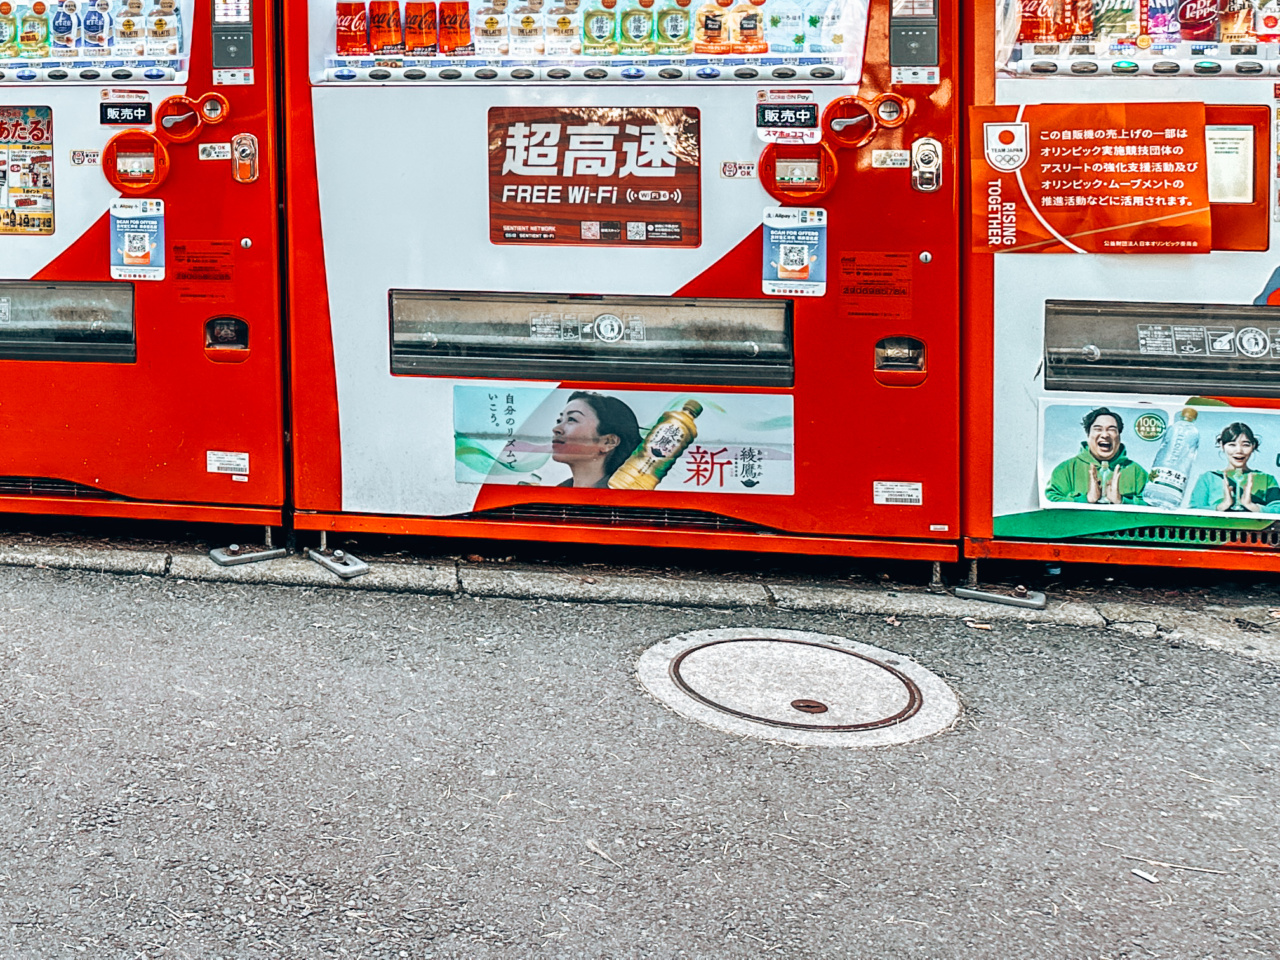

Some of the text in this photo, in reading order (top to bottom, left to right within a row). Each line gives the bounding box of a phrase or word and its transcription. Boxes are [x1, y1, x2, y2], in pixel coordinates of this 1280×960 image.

[797, 94, 809, 102] Pay
[107, 107, 147, 120] 販売中
[764, 109, 811, 123] 販売中
[1040, 128, 1188, 141] この自販機の売上げの一部は
[502, 122, 678, 178] 超高速
[1040, 145, 1184, 157] オリンピック実施競技団体の
[1040, 162, 1198, 173] アスリートの強化支援活動及び
[502, 185, 563, 203] FREE
[568, 185, 618, 204] Wi-Fi
[1040, 195, 1193, 207] 推進活動などに活用されます。
[988, 178, 1002, 246] TOGETHER
[1002, 202, 1016, 246] RISING
[487, 393, 501, 428] いこう。
[505, 393, 518, 469] 自分のリズムで
[683, 445, 733, 488] 新
[739, 446, 758, 479] 綾鷹
